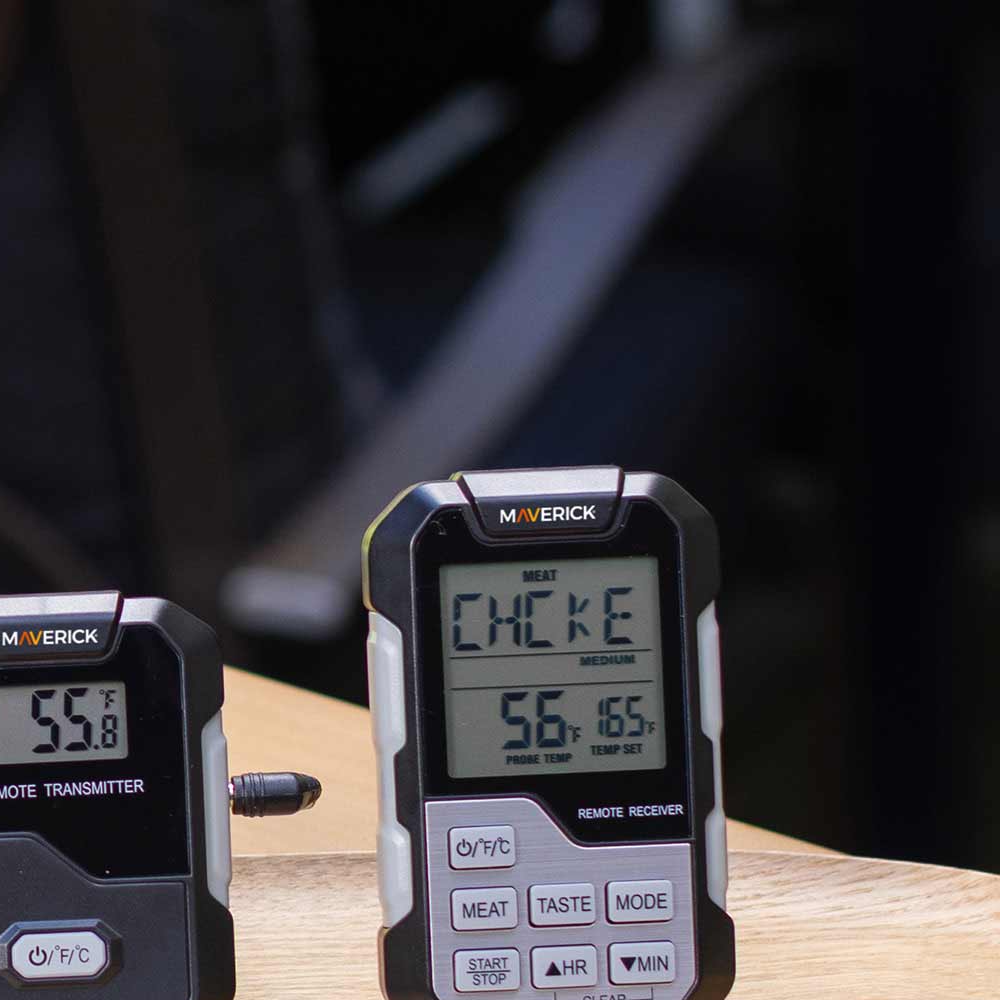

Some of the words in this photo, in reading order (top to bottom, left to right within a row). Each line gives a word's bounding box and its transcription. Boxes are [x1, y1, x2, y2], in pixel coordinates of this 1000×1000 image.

[499, 505, 597, 524] MAVERICK
[522, 569, 558, 583] MEAT
[1, 628, 98, 647] MAVERICK
[579, 654, 636, 667] MEDIUM
[590, 744, 620, 756] TEMP
[623, 743, 643, 755] SET
[506, 754, 541, 766] PROBE
[544, 752, 573, 764] TEMP
[44, 779, 144, 798] TRANSMITTER
[577, 806, 624, 820] REMOTE
[628, 804, 684, 818] RECEIVER
[462, 900, 509, 919] MEAT
[537, 896, 592, 914] TASTE
[616, 892, 668, 911] MODE
[468, 956, 509, 971] START
[562, 959, 588, 976] HR
[637, 955, 669, 973] MIN
[472, 973, 507, 986] STOP
